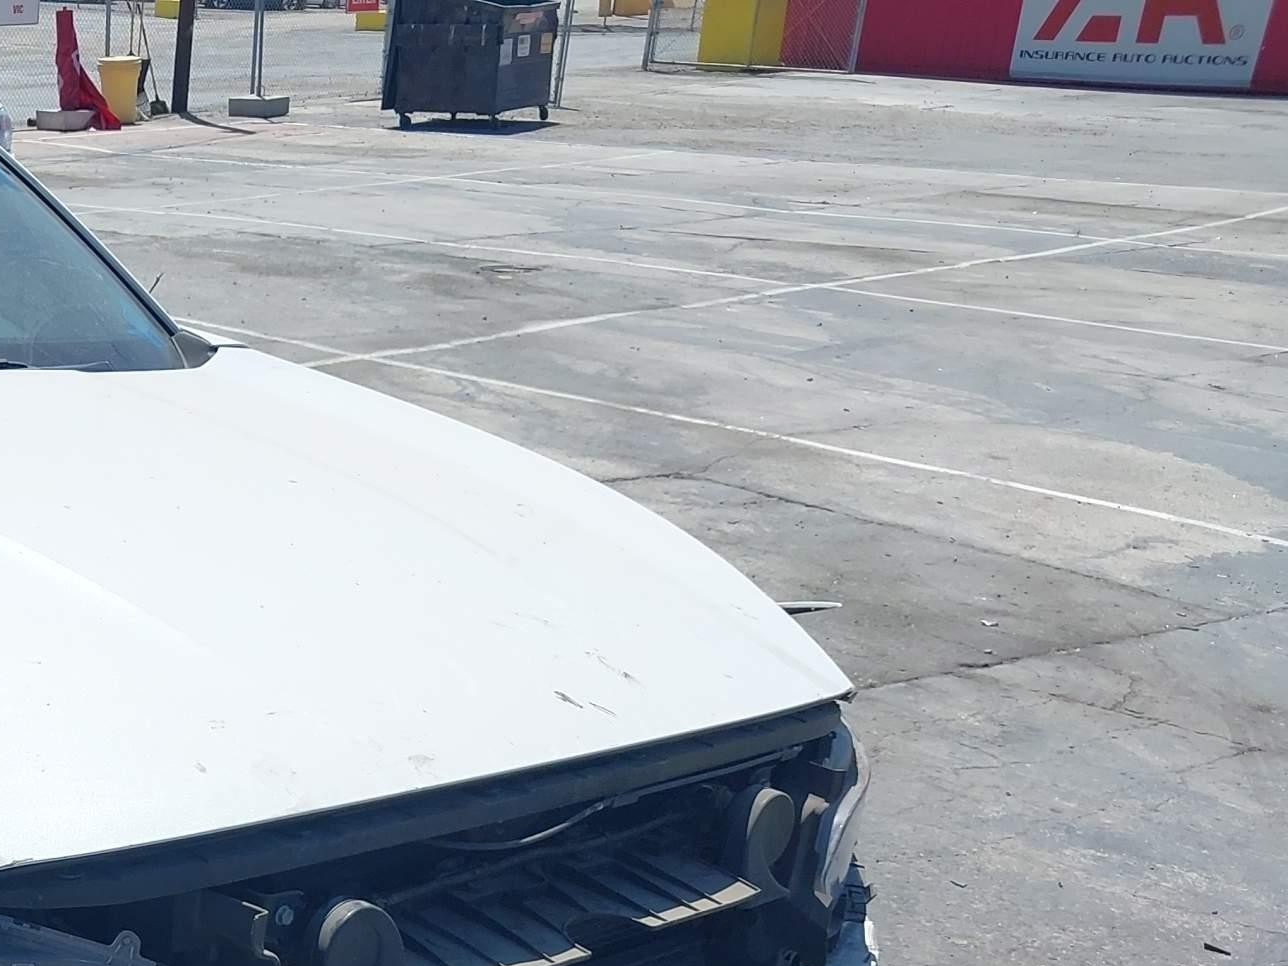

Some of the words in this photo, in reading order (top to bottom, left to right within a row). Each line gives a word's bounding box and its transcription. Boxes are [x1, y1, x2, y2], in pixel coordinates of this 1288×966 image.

[1018, 48, 1106, 63] INSURANCE
[1111, 52, 1156, 64] AUTO
[1161, 54, 1249, 67] AUCTIONS
